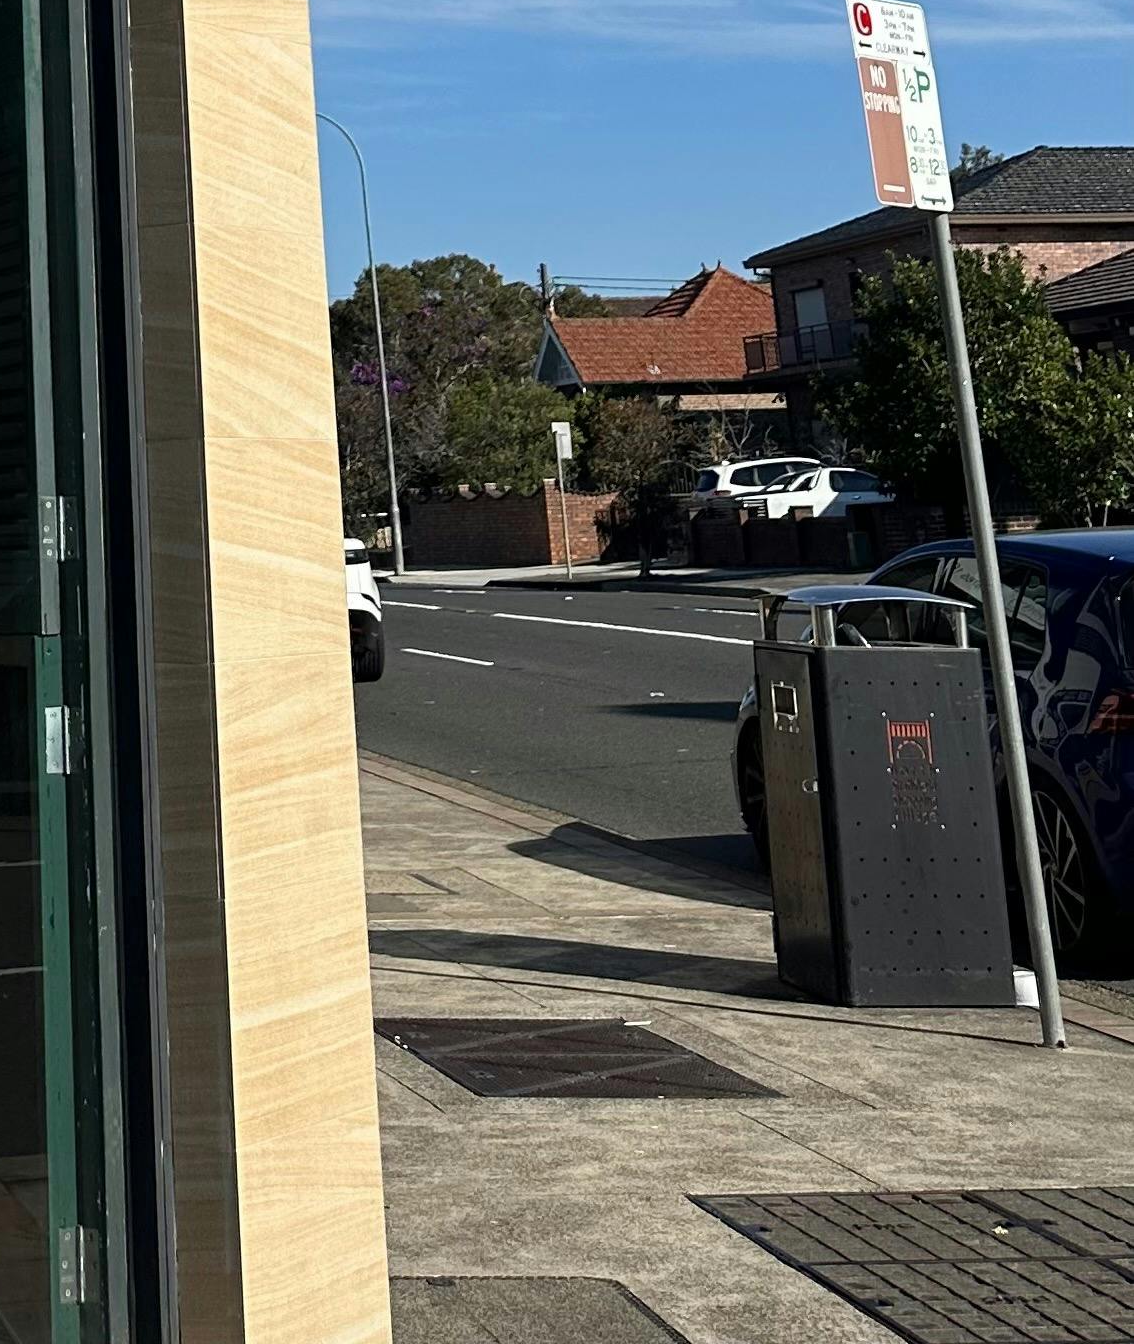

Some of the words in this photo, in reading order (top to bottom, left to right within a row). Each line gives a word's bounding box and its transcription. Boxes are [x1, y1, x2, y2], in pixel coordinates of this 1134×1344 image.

[855, 4, 871, 35] C
[869, 63, 887, 89] NO
[864, 91, 902, 115] STOPPING
